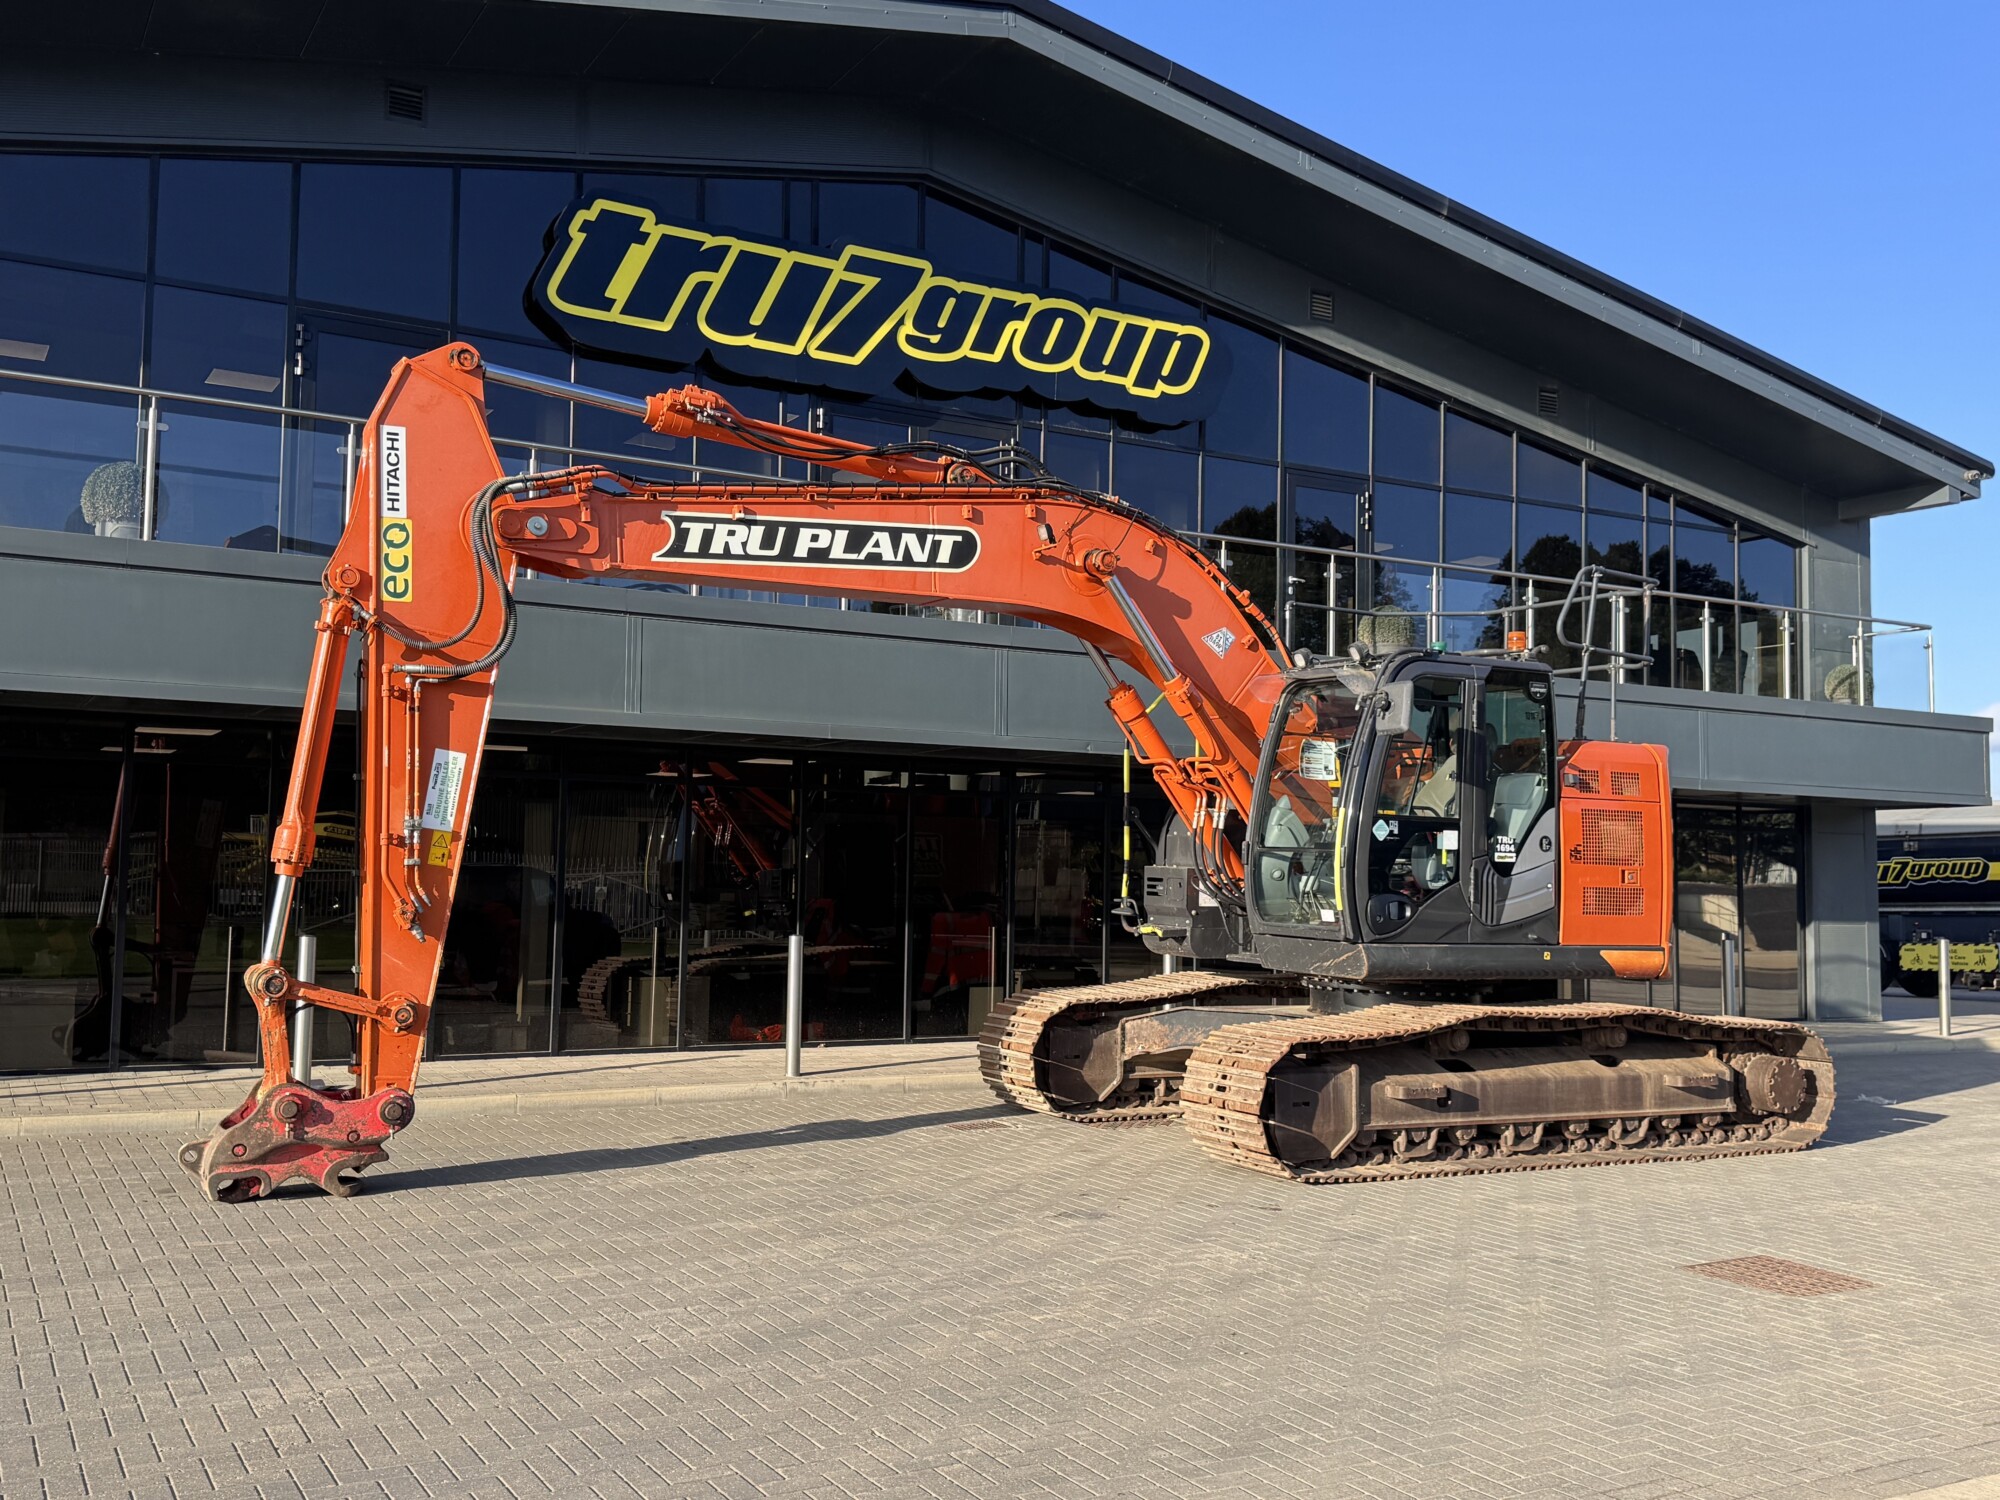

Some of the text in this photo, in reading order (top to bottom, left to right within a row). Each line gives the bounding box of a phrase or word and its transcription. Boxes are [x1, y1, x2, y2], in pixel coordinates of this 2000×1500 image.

[546, 198, 1210, 399] tru7group
[386, 431, 400, 512] HITACHI
[382, 522, 410, 599] eco
[680, 521, 962, 563] TRU PLANT
[434, 788, 444, 819] GENUINE
[440, 761, 449, 786] MILLER
[440, 756, 458, 826] TWINLOCK COUPLER
[1496, 844, 1514, 852] 1694
[1497, 836, 1514, 844] TRU
